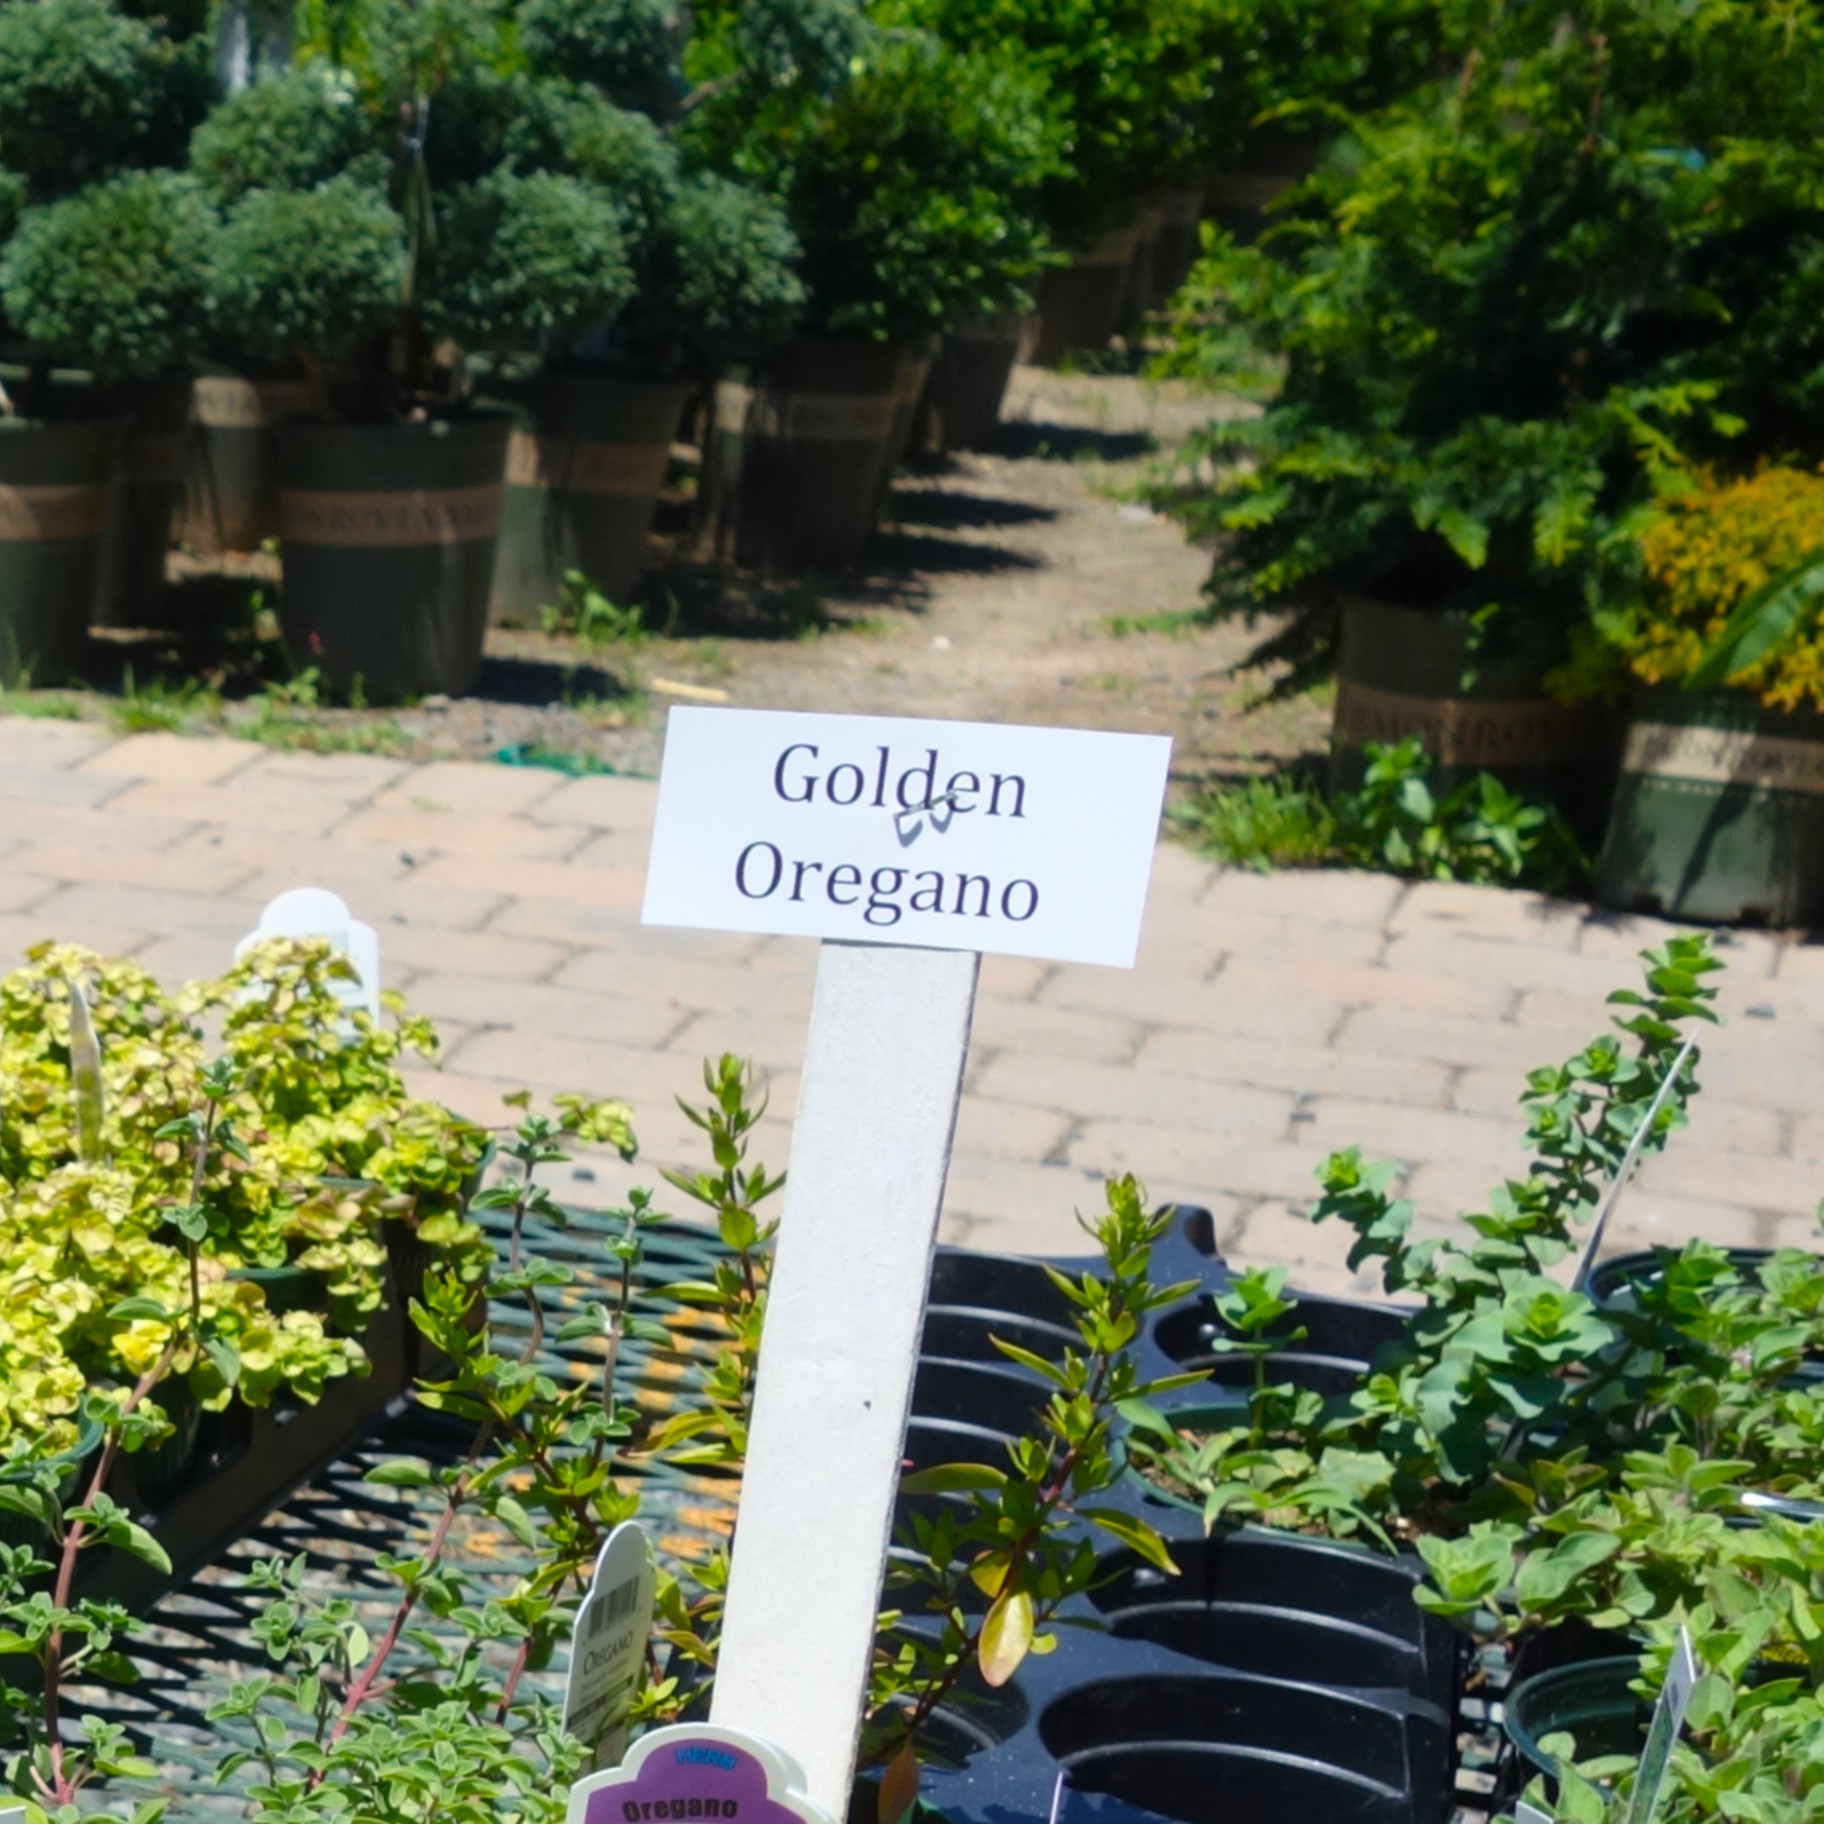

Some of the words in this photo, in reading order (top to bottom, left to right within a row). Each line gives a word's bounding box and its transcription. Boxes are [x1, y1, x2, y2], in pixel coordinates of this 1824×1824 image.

[773, 743, 1027, 819] Golden
[734, 840, 1040, 926] Oregano
[675, 1746, 738, 1771] HERB
[621, 1797, 739, 1824] Oregano
